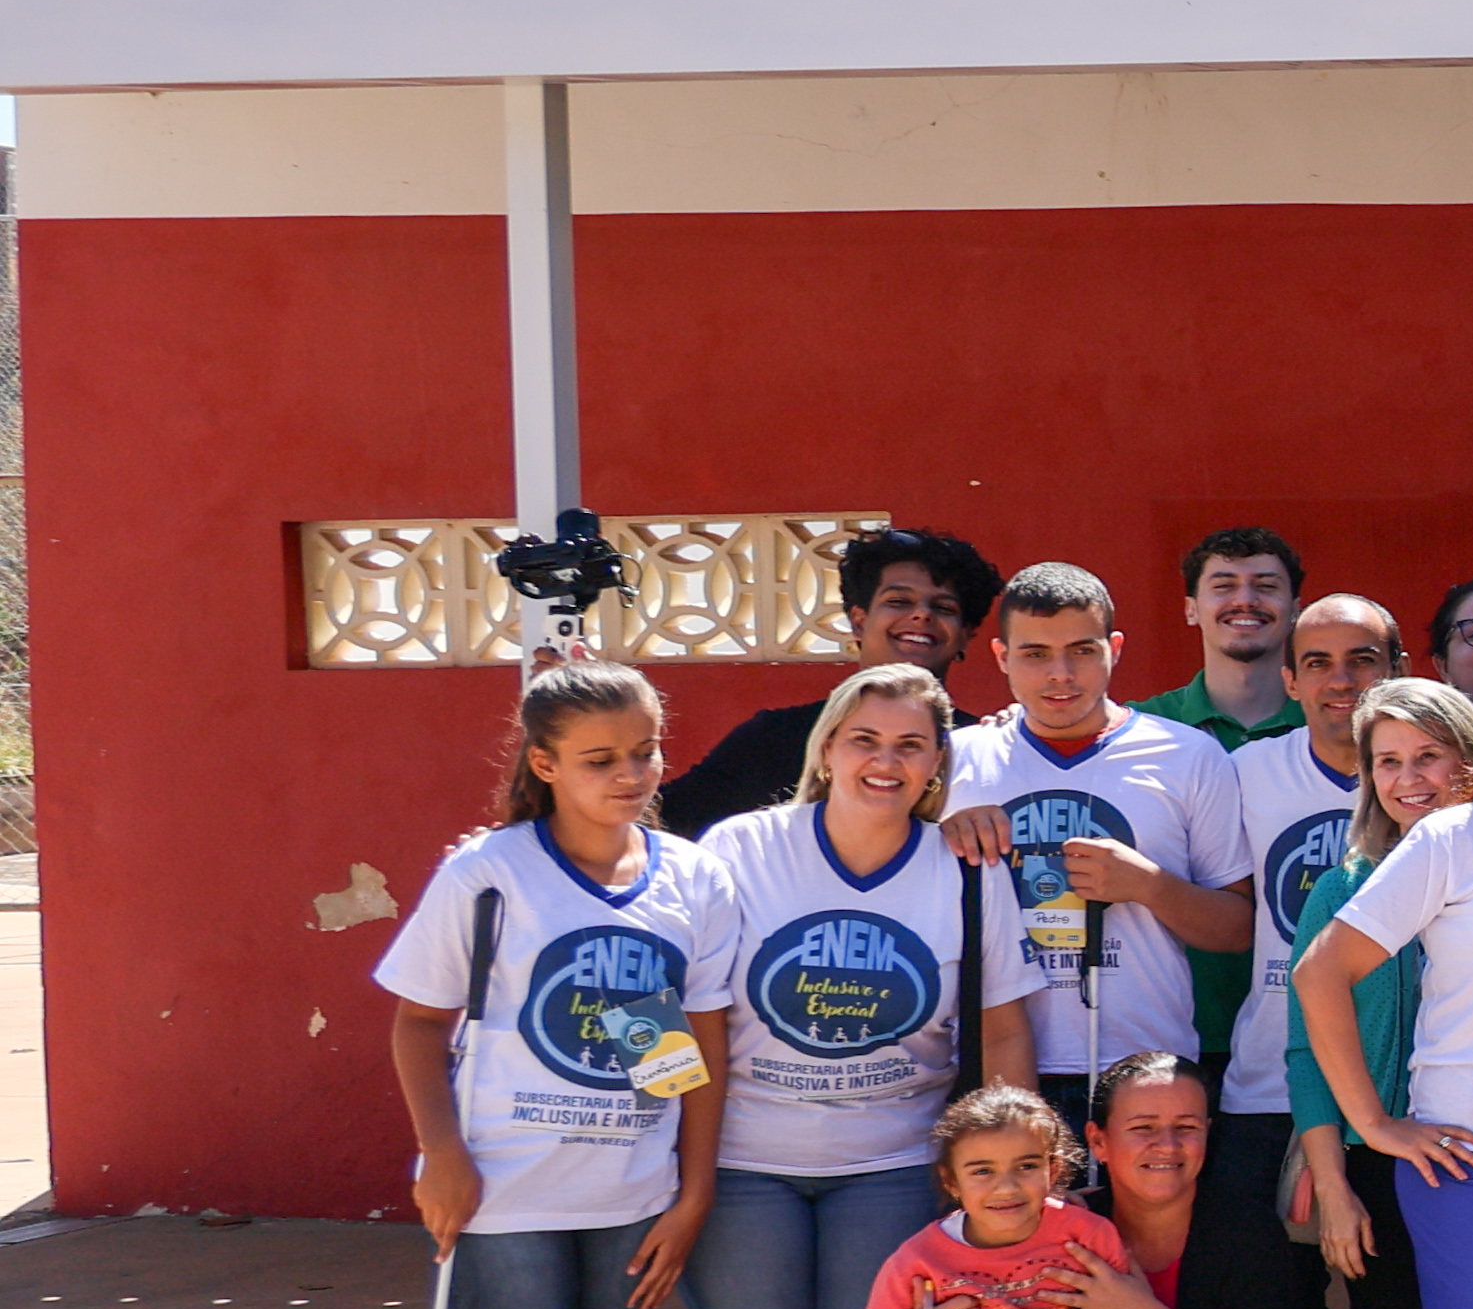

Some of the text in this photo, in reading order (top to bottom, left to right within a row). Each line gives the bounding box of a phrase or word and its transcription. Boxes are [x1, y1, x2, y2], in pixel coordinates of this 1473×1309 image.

[1012, 798, 1092, 845] ENEM
[1034, 911, 1070, 926] Pedro
[801, 919, 895, 971] ENEM
[575, 936, 670, 993] ENEM
[796, 972, 874, 996] Inclusivo
[806, 994, 878, 1019] Especial
[752, 1057, 842, 1075] SUBSECRETARIA
[847, 1063, 861, 1074] DE
[752, 1067, 917, 1091] INCLUSIVA E INTEGRAL
[514, 1092, 613, 1110] SUBSECRETARIA
[617, 1097, 634, 1109] DE
[512, 1106, 597, 1127] INCLUSIVA
[602, 1111, 612, 1128] E
